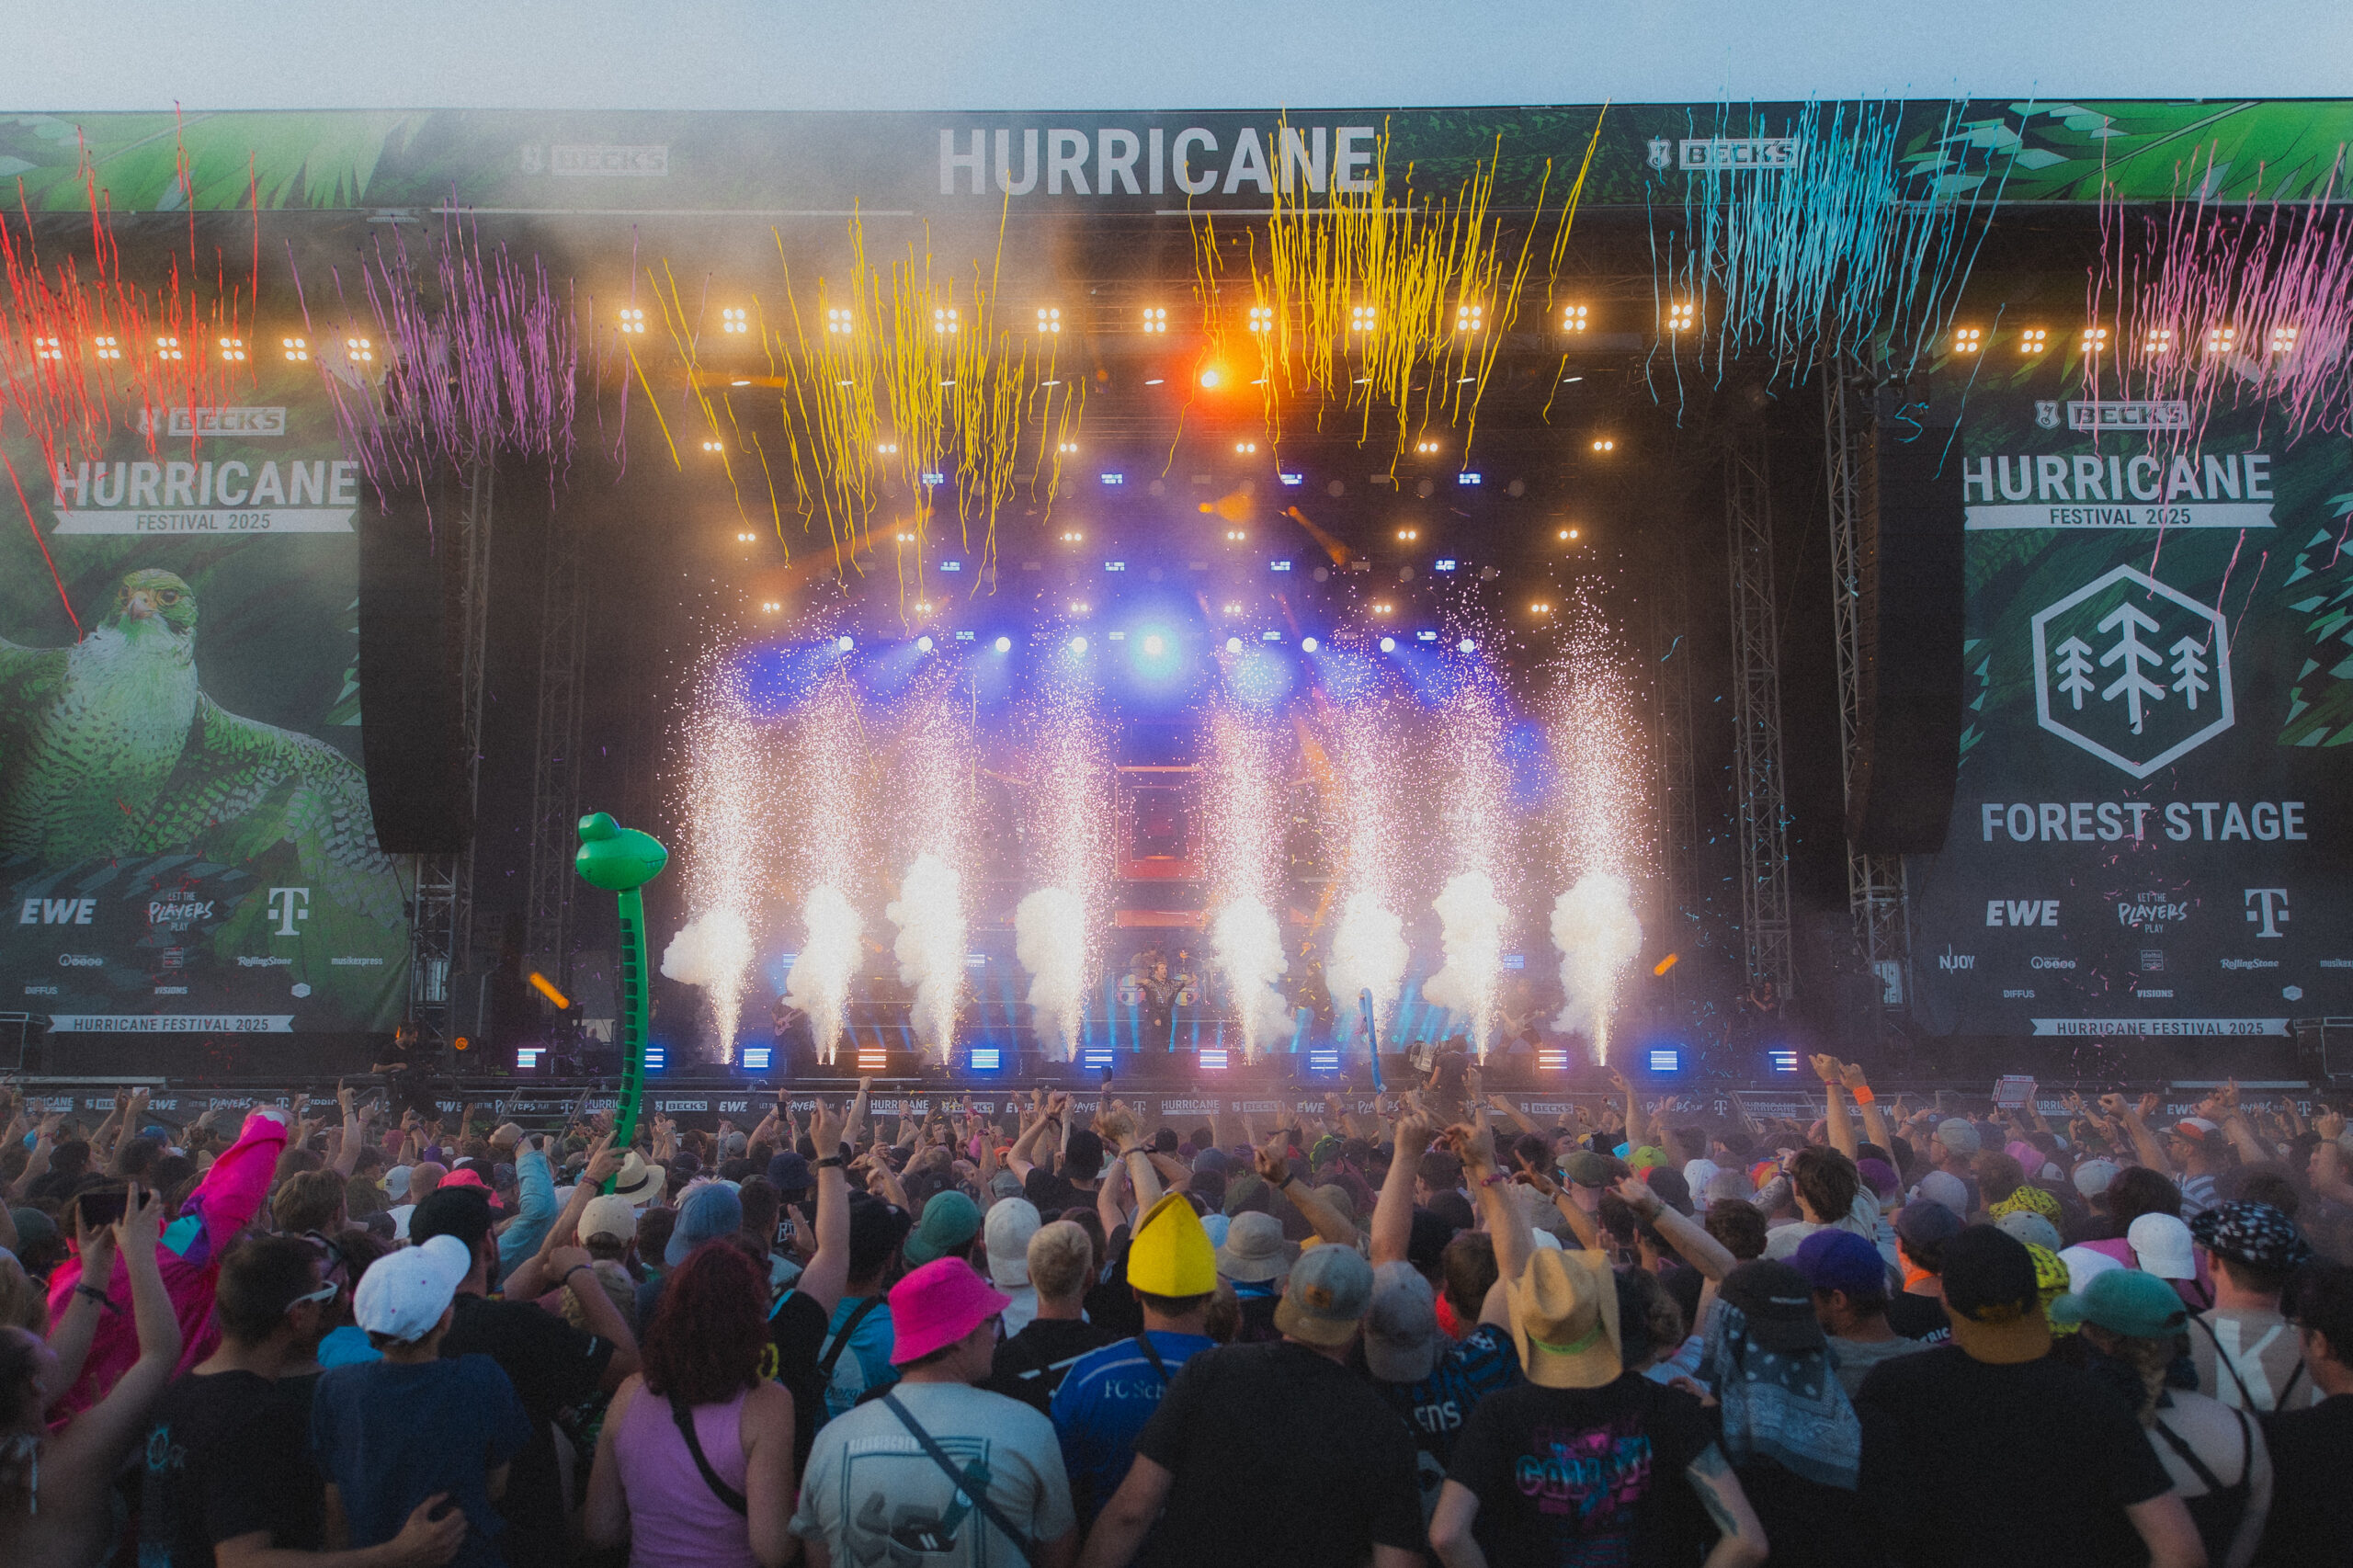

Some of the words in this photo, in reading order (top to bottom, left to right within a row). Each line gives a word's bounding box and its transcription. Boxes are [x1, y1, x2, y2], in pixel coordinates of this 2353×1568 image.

[938, 127, 1375, 196] HURRICANE
[53, 460, 359, 507] HURRICANE
[1963, 454, 2274, 503] HURRICANE
[137, 514, 219, 530] FESTIVAL
[228, 513, 271, 529] 2025
[2050, 508, 2137, 525] FESTIVAL
[2145, 508, 2191, 525] 2025
[1982, 801, 2153, 842] FOREST
[2165, 801, 2308, 841] STAGE
[168, 892, 182, 901] LET
[183, 892, 196, 901] THE
[2137, 892, 2150, 903] LET
[2152, 892, 2167, 903] THE
[19, 898, 97, 925] EWE
[148, 900, 215, 924] PLAYERS
[1985, 899, 2061, 926] EWE
[2118, 901, 2188, 926] PLAYERS
[170, 922, 189, 932] PLAY
[2144, 923, 2164, 934] PLAY
[154, 986, 188, 995] VISIONS
[2136, 989, 2175, 998] VISIONS
[74, 1018, 157, 1030] HURRICANE
[163, 1018, 230, 1030] FESTIVAL
[235, 1017, 269, 1030] 2025
[2057, 1022, 2147, 1035] HURRICANE
[2152, 1022, 2224, 1035] FESTIVAL
[2229, 1022, 2264, 1034] 2025
[148, 1099, 178, 1110] EWE
[210, 1097, 253, 1111] PLAYERS
[719, 1101, 748, 1112] EWE
[1161, 1099, 1221, 1109] HURRICANE
[1296, 1102, 1325, 1113] EWE
[1104, 1379, 1130, 1399] FC
